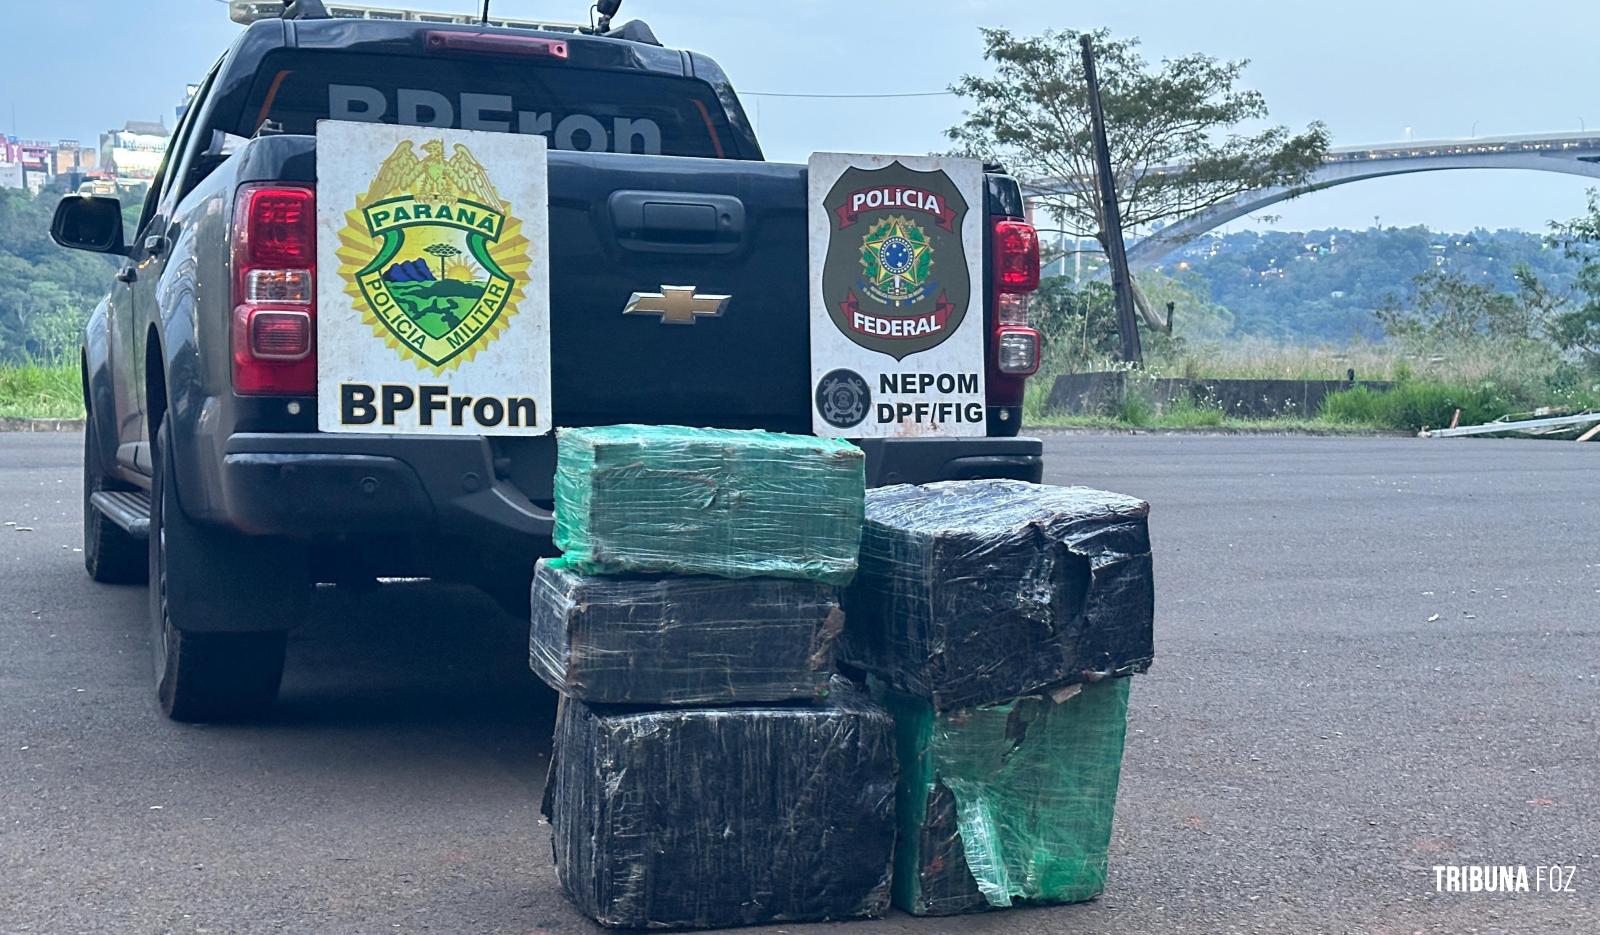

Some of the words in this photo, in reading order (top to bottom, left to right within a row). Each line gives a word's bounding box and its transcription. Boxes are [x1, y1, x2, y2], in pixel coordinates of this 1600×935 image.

[371, 203, 497, 235] PARANÁ
[448, 282, 505, 350] MILITAR
[853, 311, 941, 336] FEDERAL
[879, 373, 979, 394] NEPOM
[339, 383, 538, 428] BPFron
[877, 402, 984, 424] DPF/FIG
